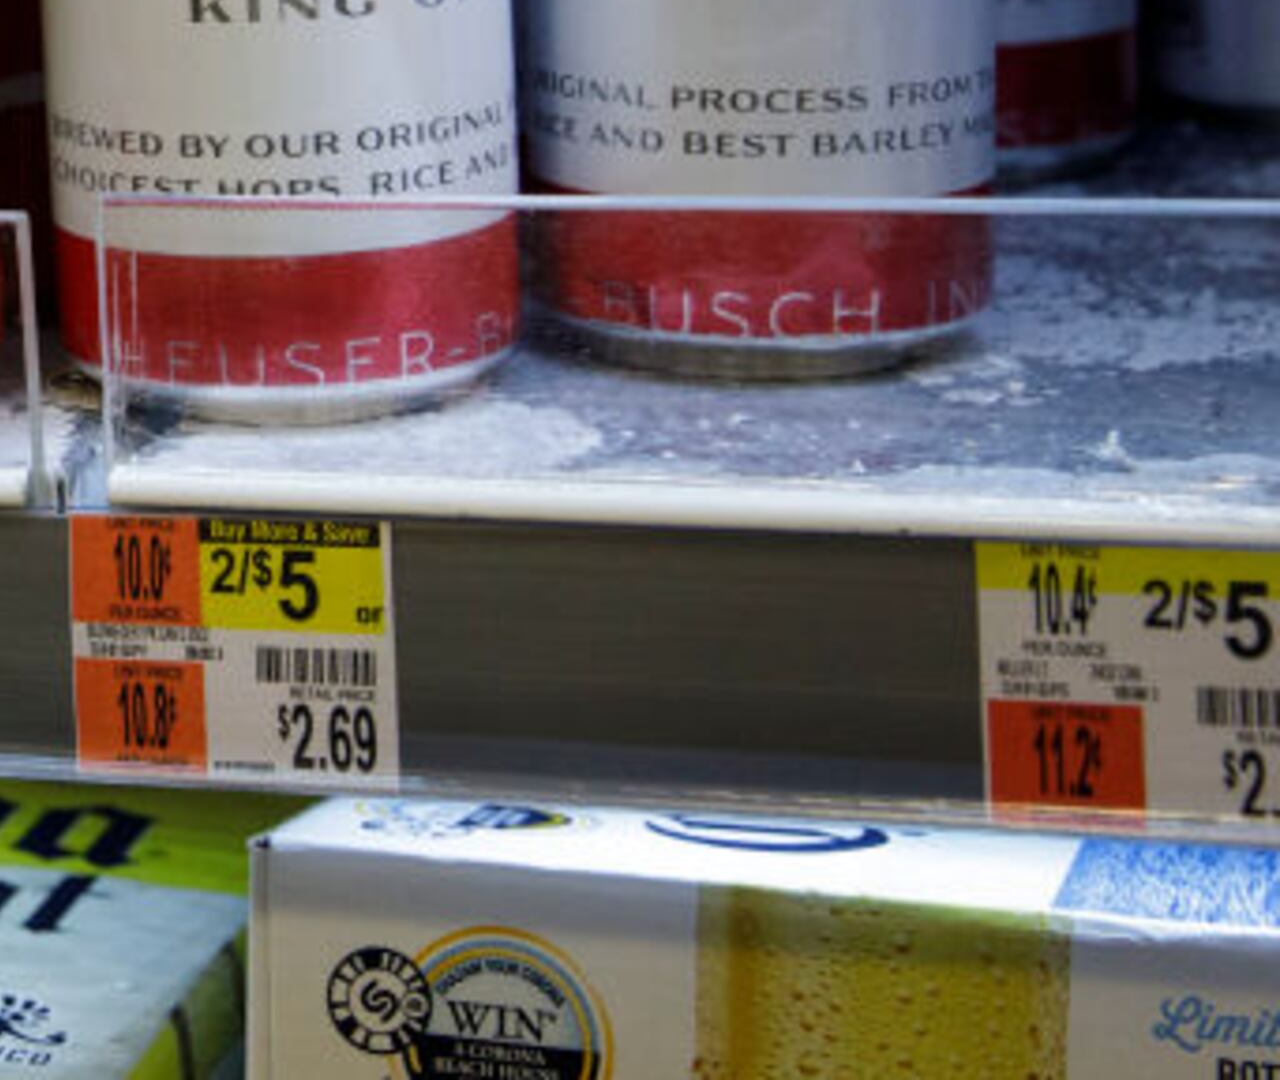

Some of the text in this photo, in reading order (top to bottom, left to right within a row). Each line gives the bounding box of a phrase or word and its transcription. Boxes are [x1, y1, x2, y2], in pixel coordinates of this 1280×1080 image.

[669, 84, 870, 115] PROCESS
[886, 72, 974, 109] FROM
[177, 134, 231, 160] BY
[243, 129, 341, 160] OUR
[588, 120, 957, 159] AND BEST BARLEY
[368, 158, 455, 198] RICE
[602, 279, 882, 339] BUSCH
[209, 520, 372, 544] Buy More & Save
[209, 546, 320, 623] 2/$5
[356, 606, 384, 625] or
[1141, 579, 1273, 660] 2/$5
[277, 703, 378, 773] $2.69
